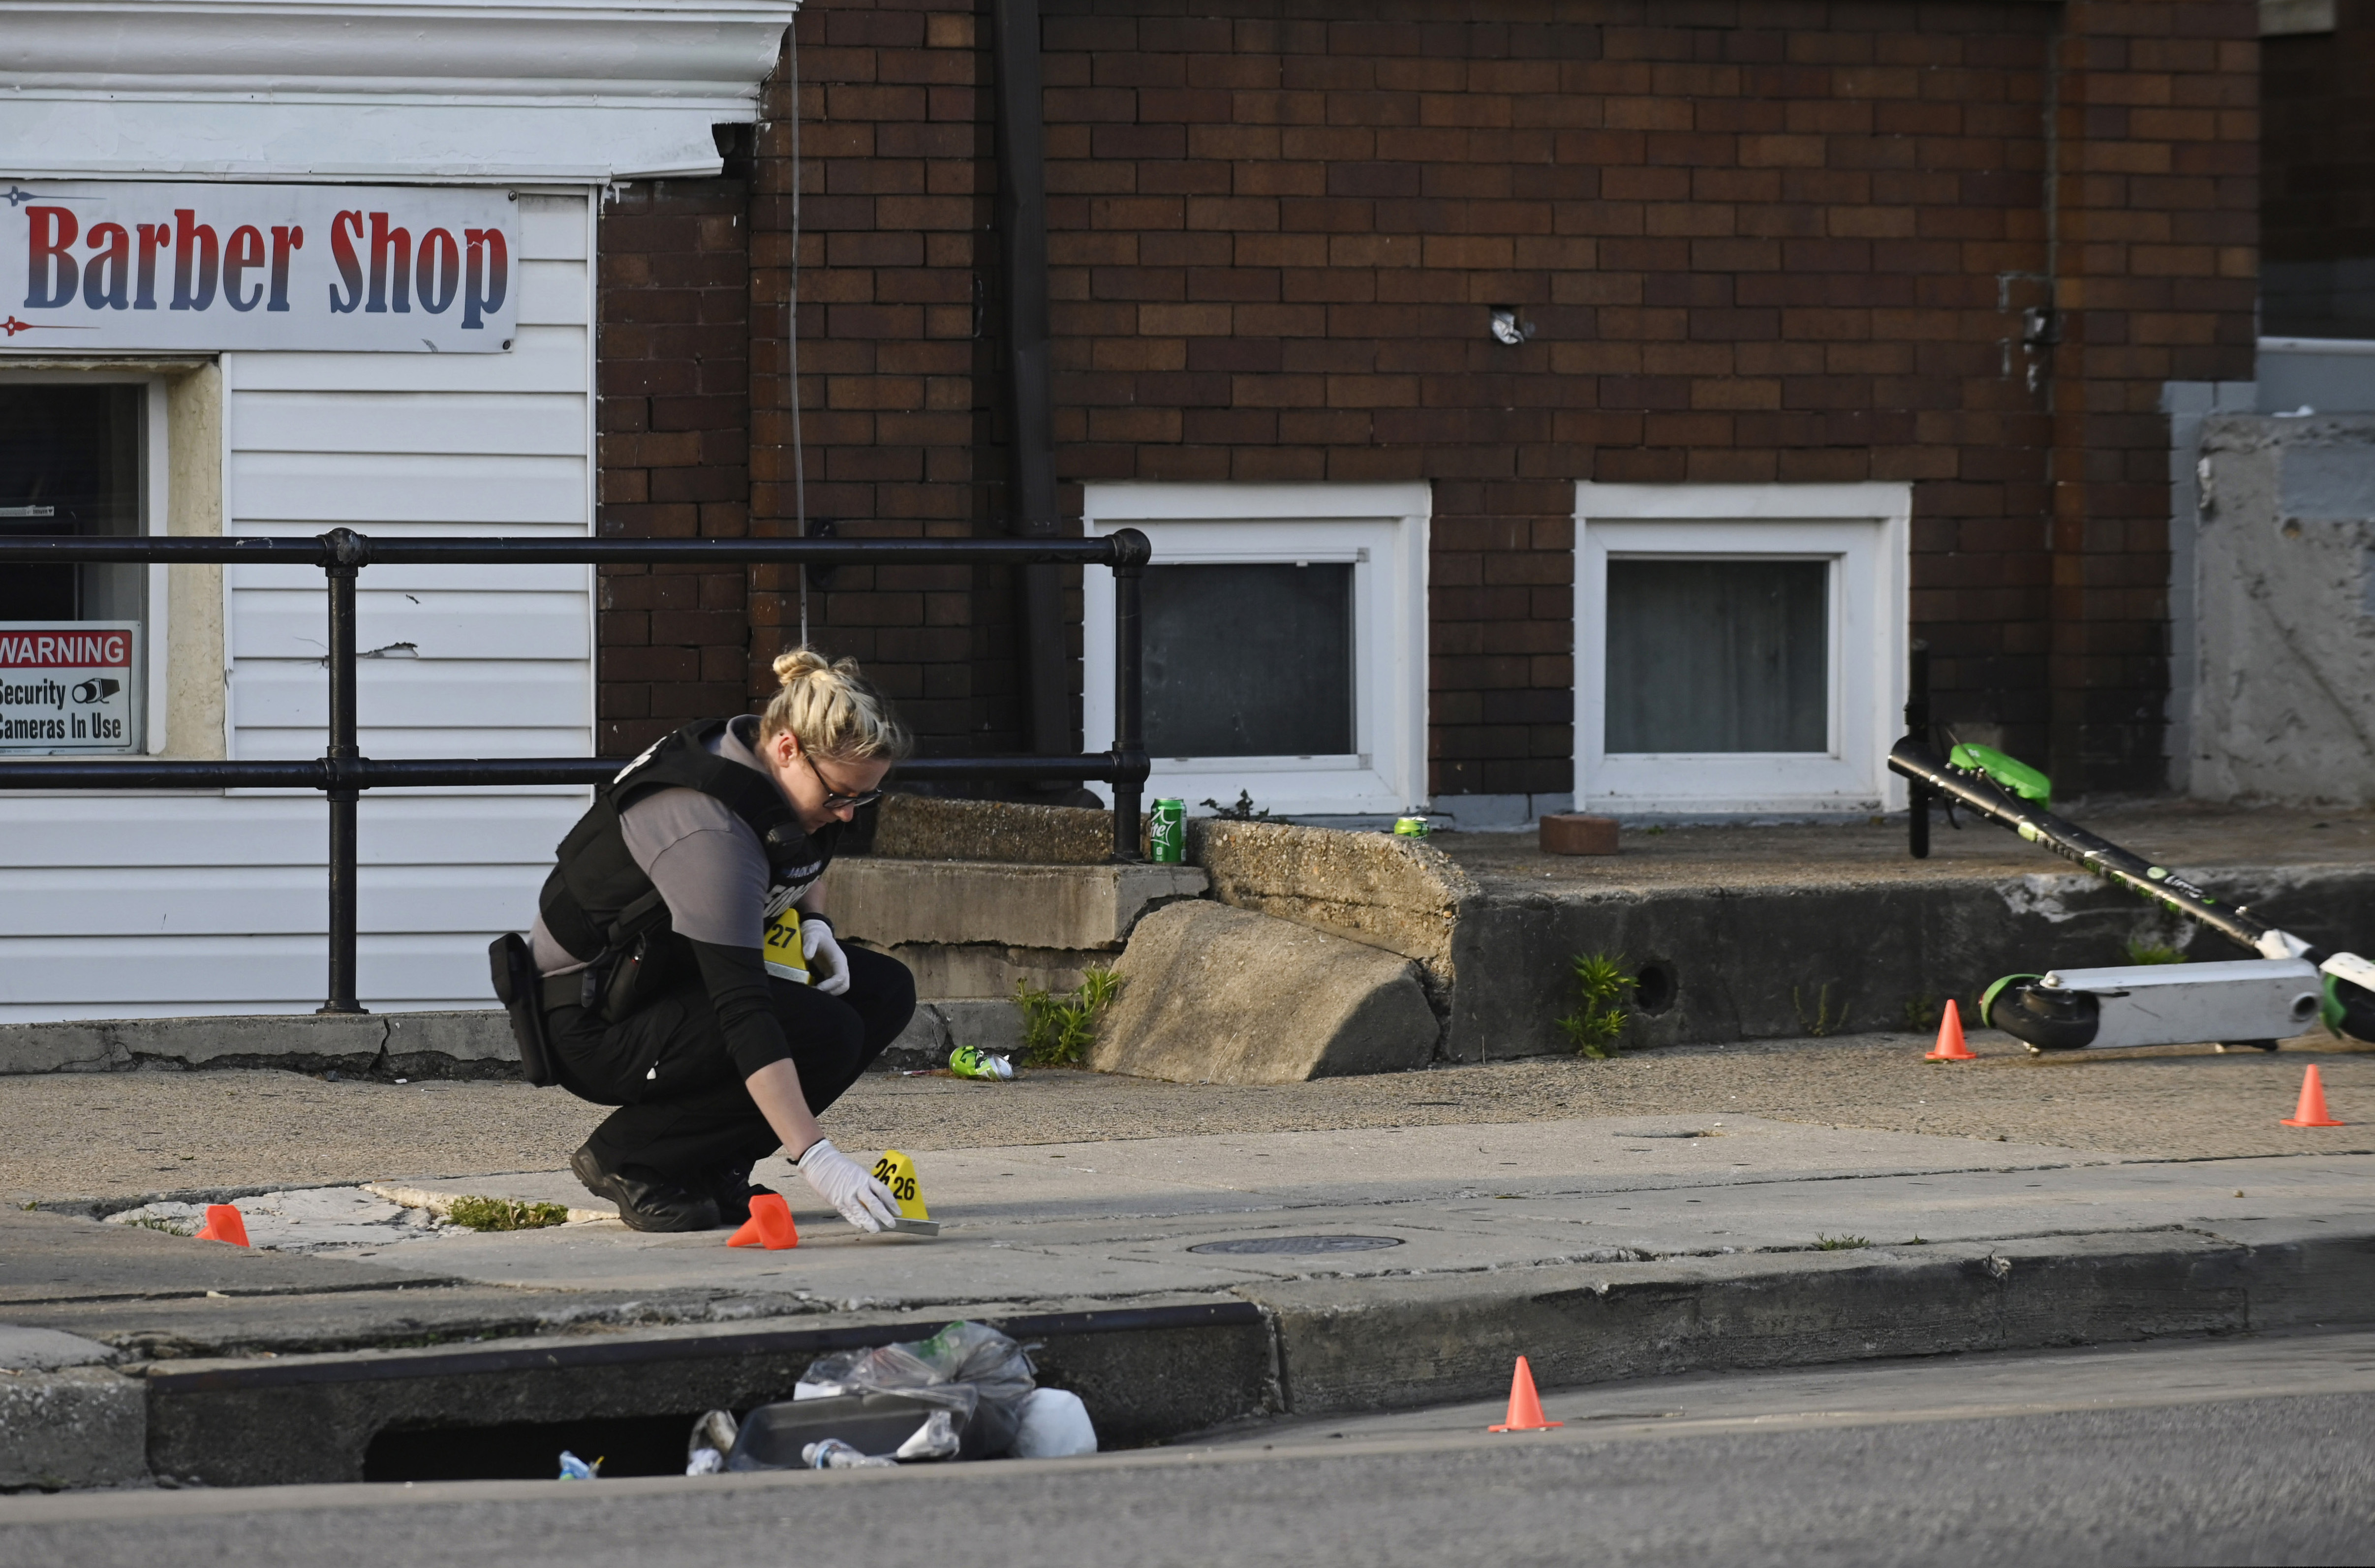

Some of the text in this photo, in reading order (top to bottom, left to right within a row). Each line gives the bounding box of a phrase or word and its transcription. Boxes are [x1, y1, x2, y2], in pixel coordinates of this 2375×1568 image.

[24, 206, 508, 329] Barber Shop
[0, 636, 123, 663] WARNING
[71, 712, 86, 738] In
[92, 712, 121, 738] Use
[767, 923, 797, 949] 27
[893, 1176, 916, 1200] 26
